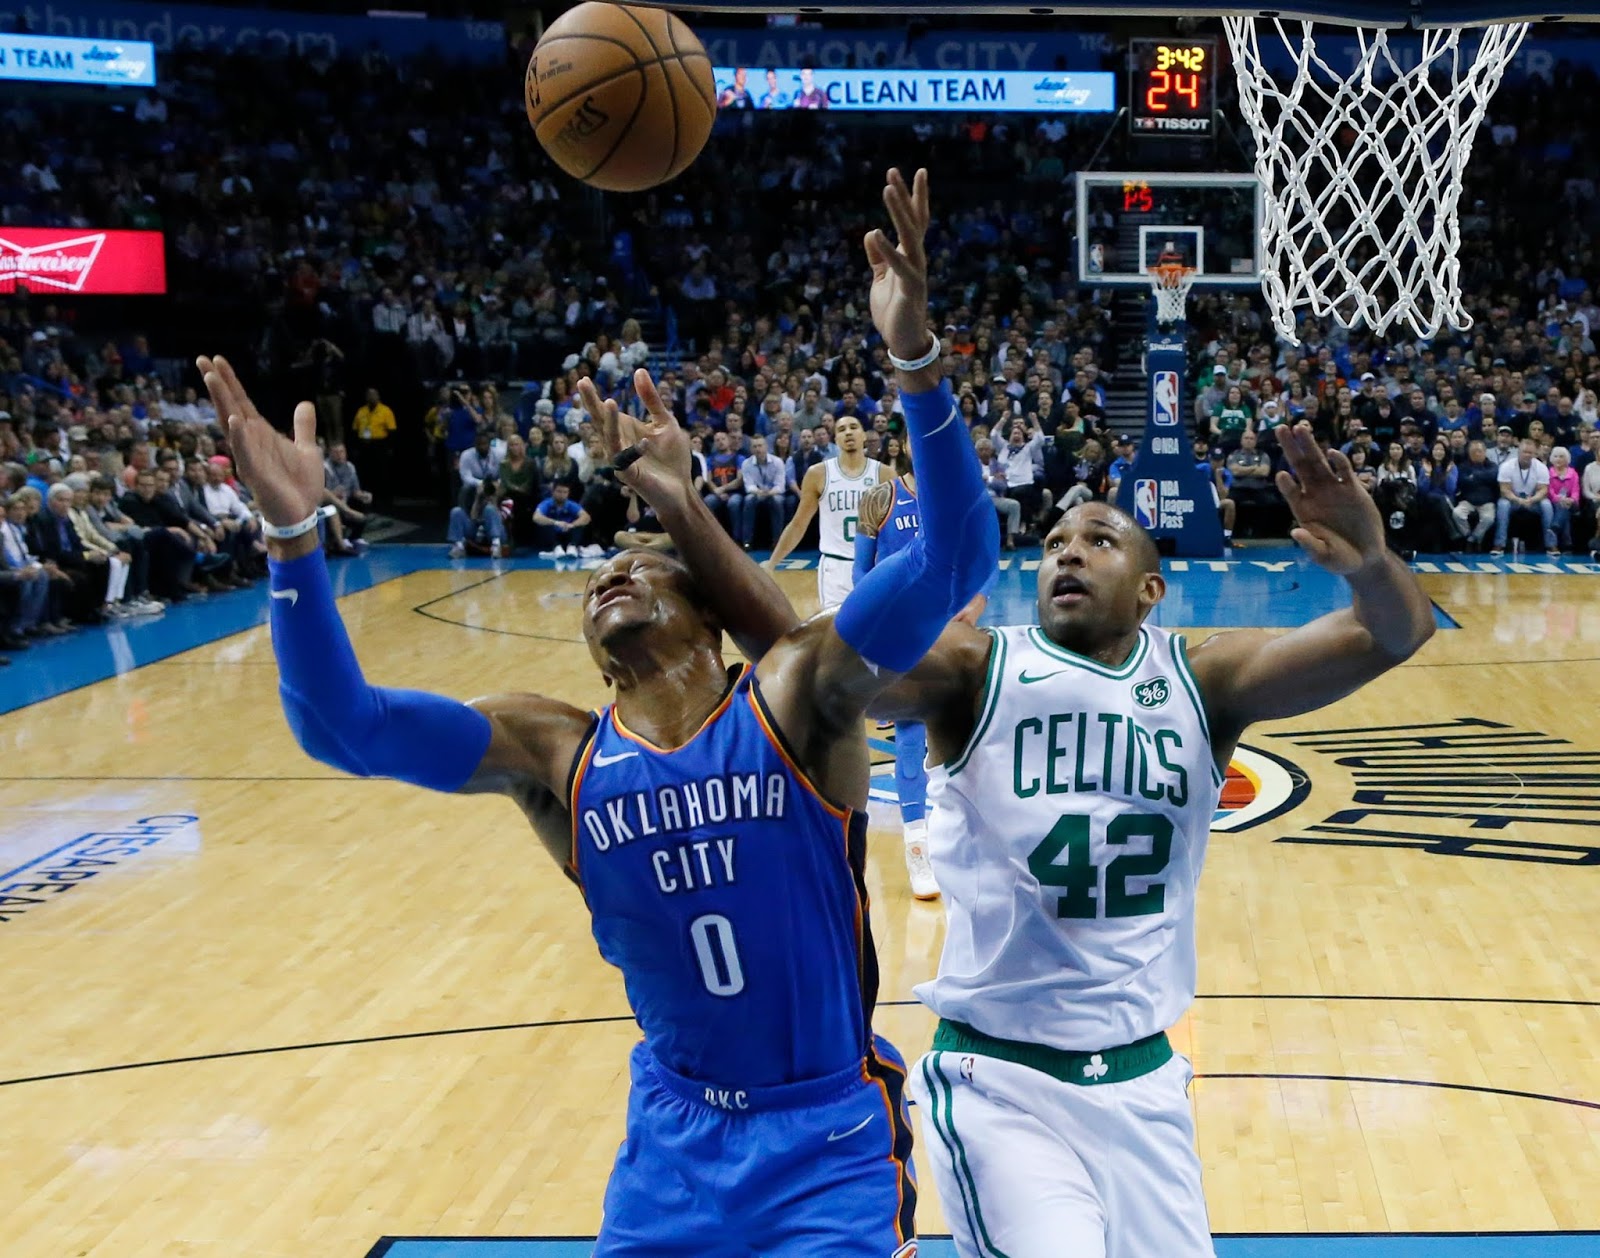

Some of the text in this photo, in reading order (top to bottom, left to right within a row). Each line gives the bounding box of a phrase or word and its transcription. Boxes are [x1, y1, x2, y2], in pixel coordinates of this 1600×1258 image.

[0, 4, 337, 57] thunder.com
[14, 48, 74, 70] TEAM
[704, 38, 1037, 70] KLAHOMA CITY
[1157, 45, 1204, 71] 3:42
[826, 78, 1006, 105] CLEAN TEAM
[1146, 71, 1199, 109] 24
[1155, 118, 1209, 131] TISSOT
[828, 490, 864, 513] CELTI
[1160, 480, 1180, 497] NBA
[1160, 497, 1195, 516] League
[1160, 513, 1184, 529] Pass
[1013, 712, 1189, 808] CELTICS
[583, 773, 786, 852] OKLAHOMA
[651, 838, 735, 894] CITY
[1027, 813, 1175, 919] 42
[690, 913, 745, 997] 0
[704, 1087, 749, 1110] OKC
